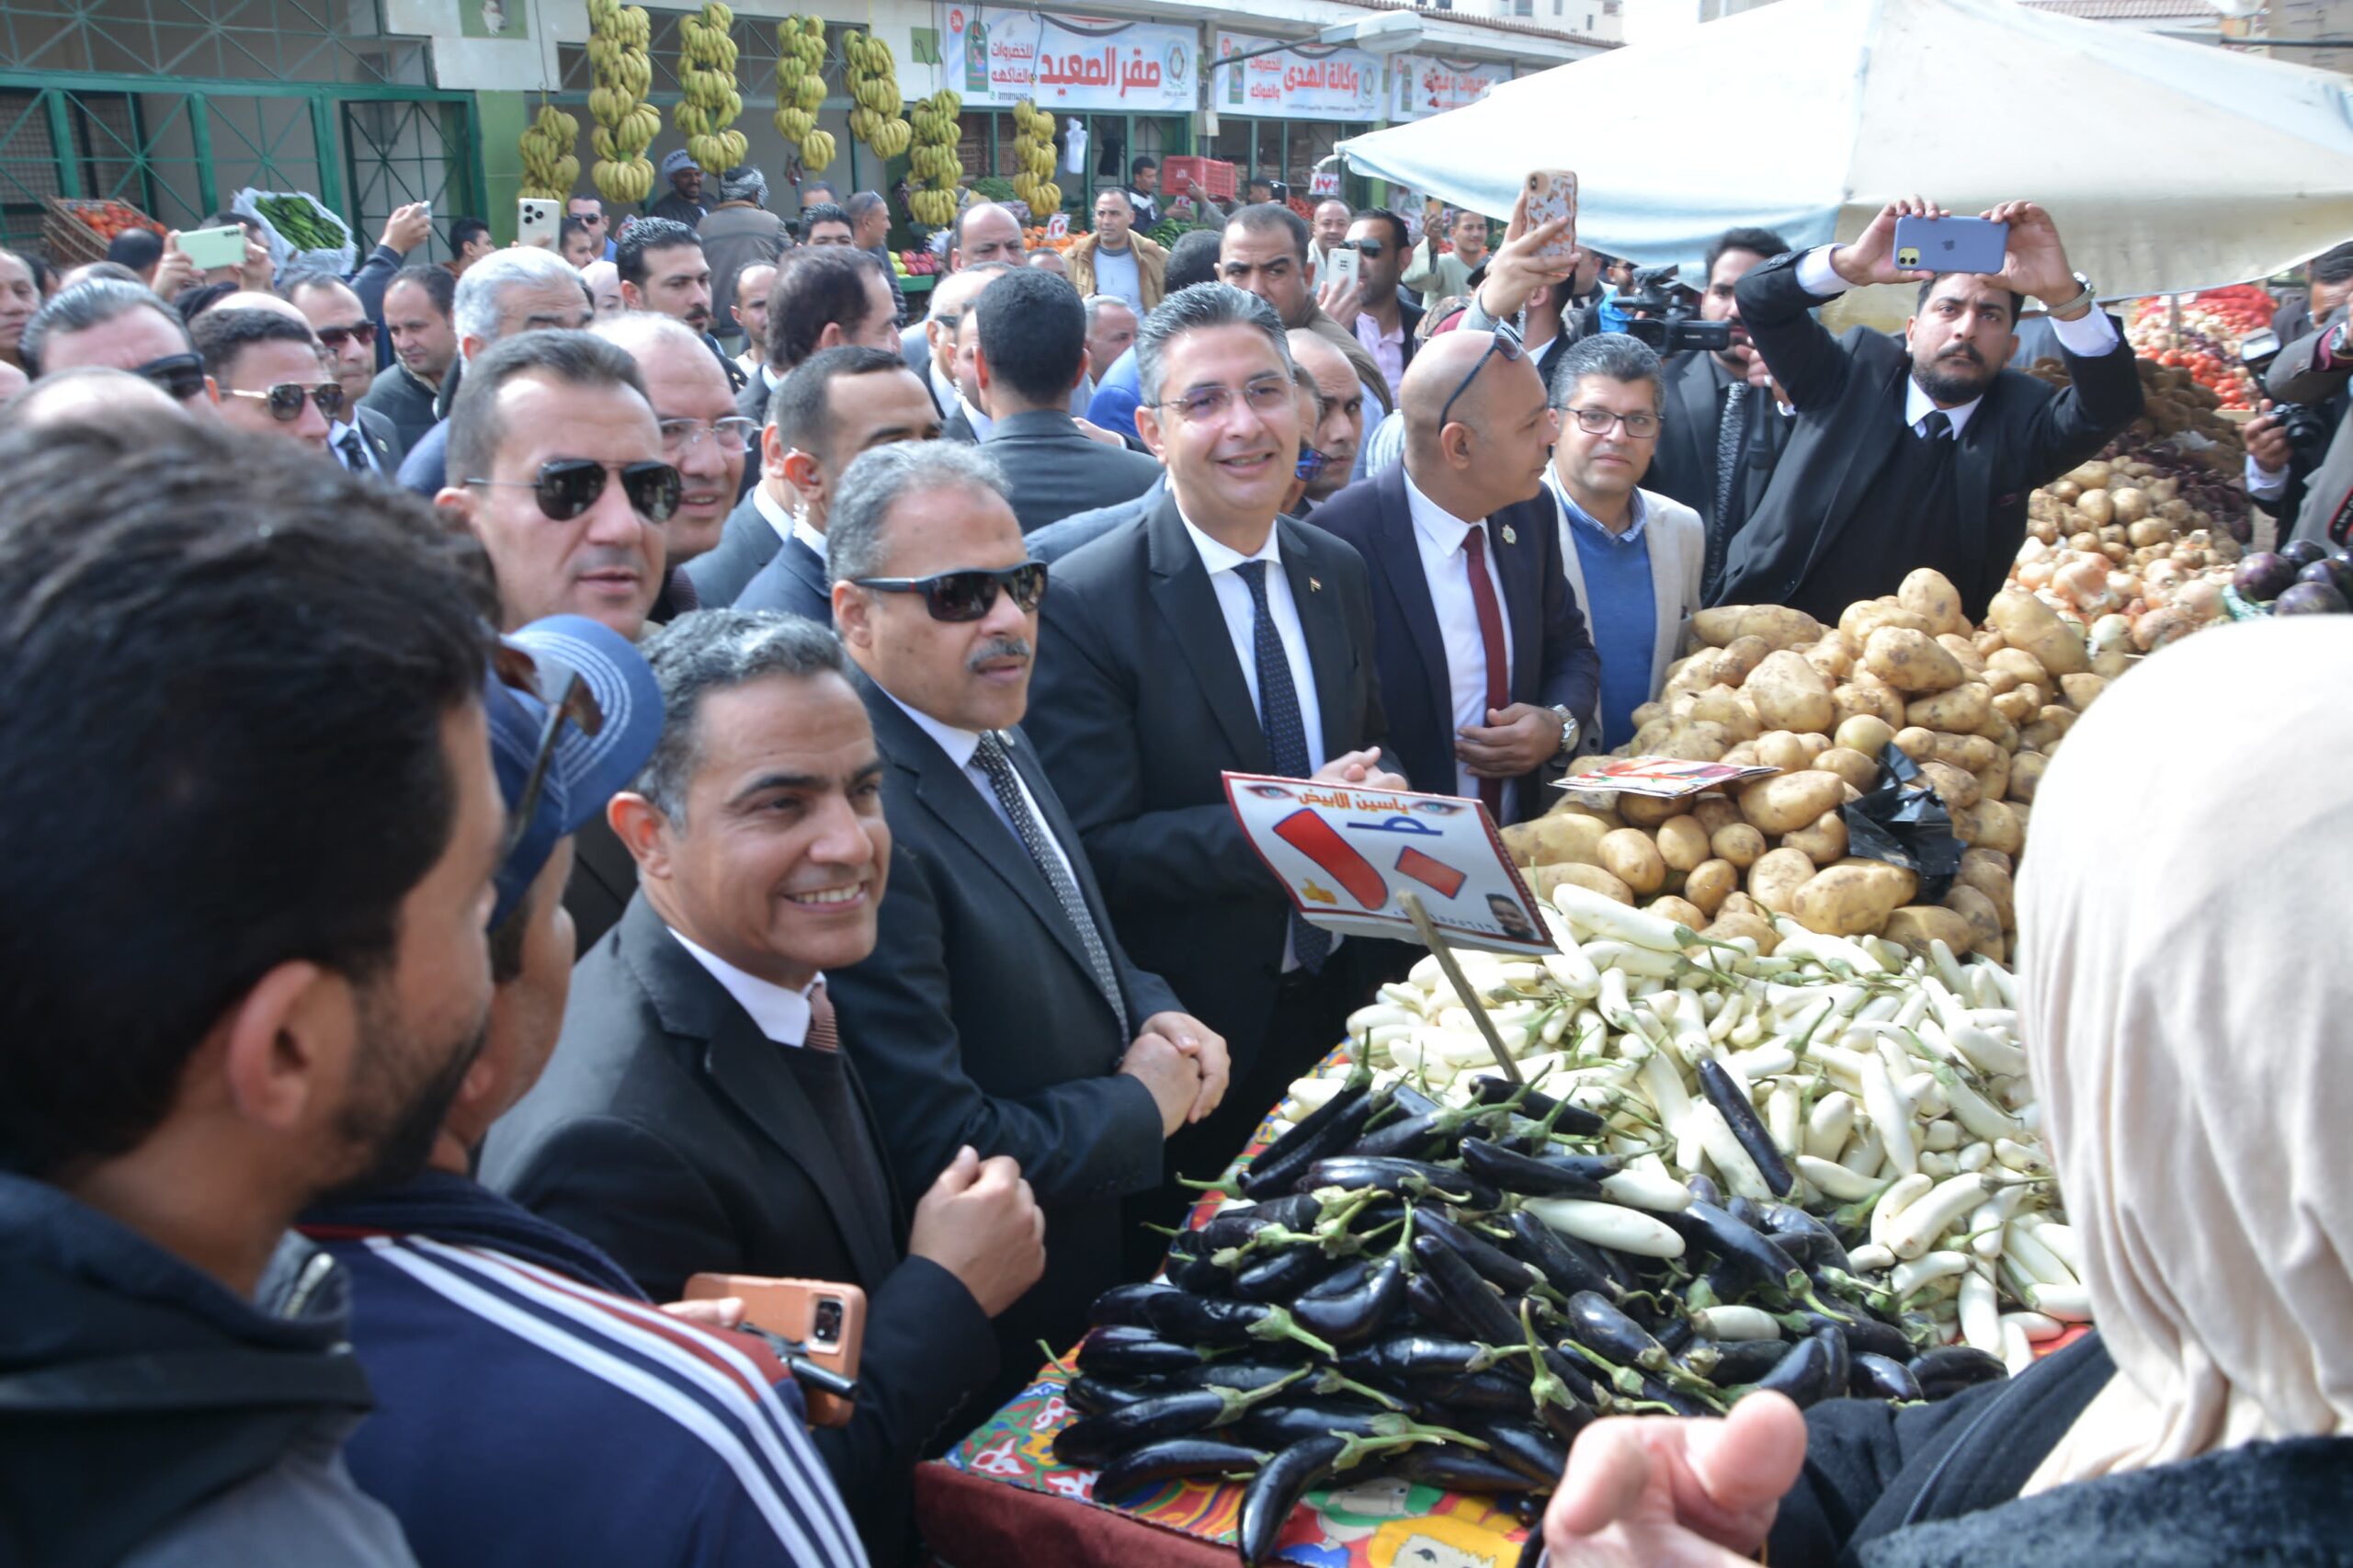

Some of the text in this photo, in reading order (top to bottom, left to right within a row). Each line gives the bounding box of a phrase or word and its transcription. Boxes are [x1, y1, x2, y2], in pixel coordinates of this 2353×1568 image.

[1039, 46, 1116, 96] الصعيد
[1283, 61, 1325, 92] الهدى
[1329, 62, 1358, 97] وكالة
[1356, 793, 1409, 815] ياسين
